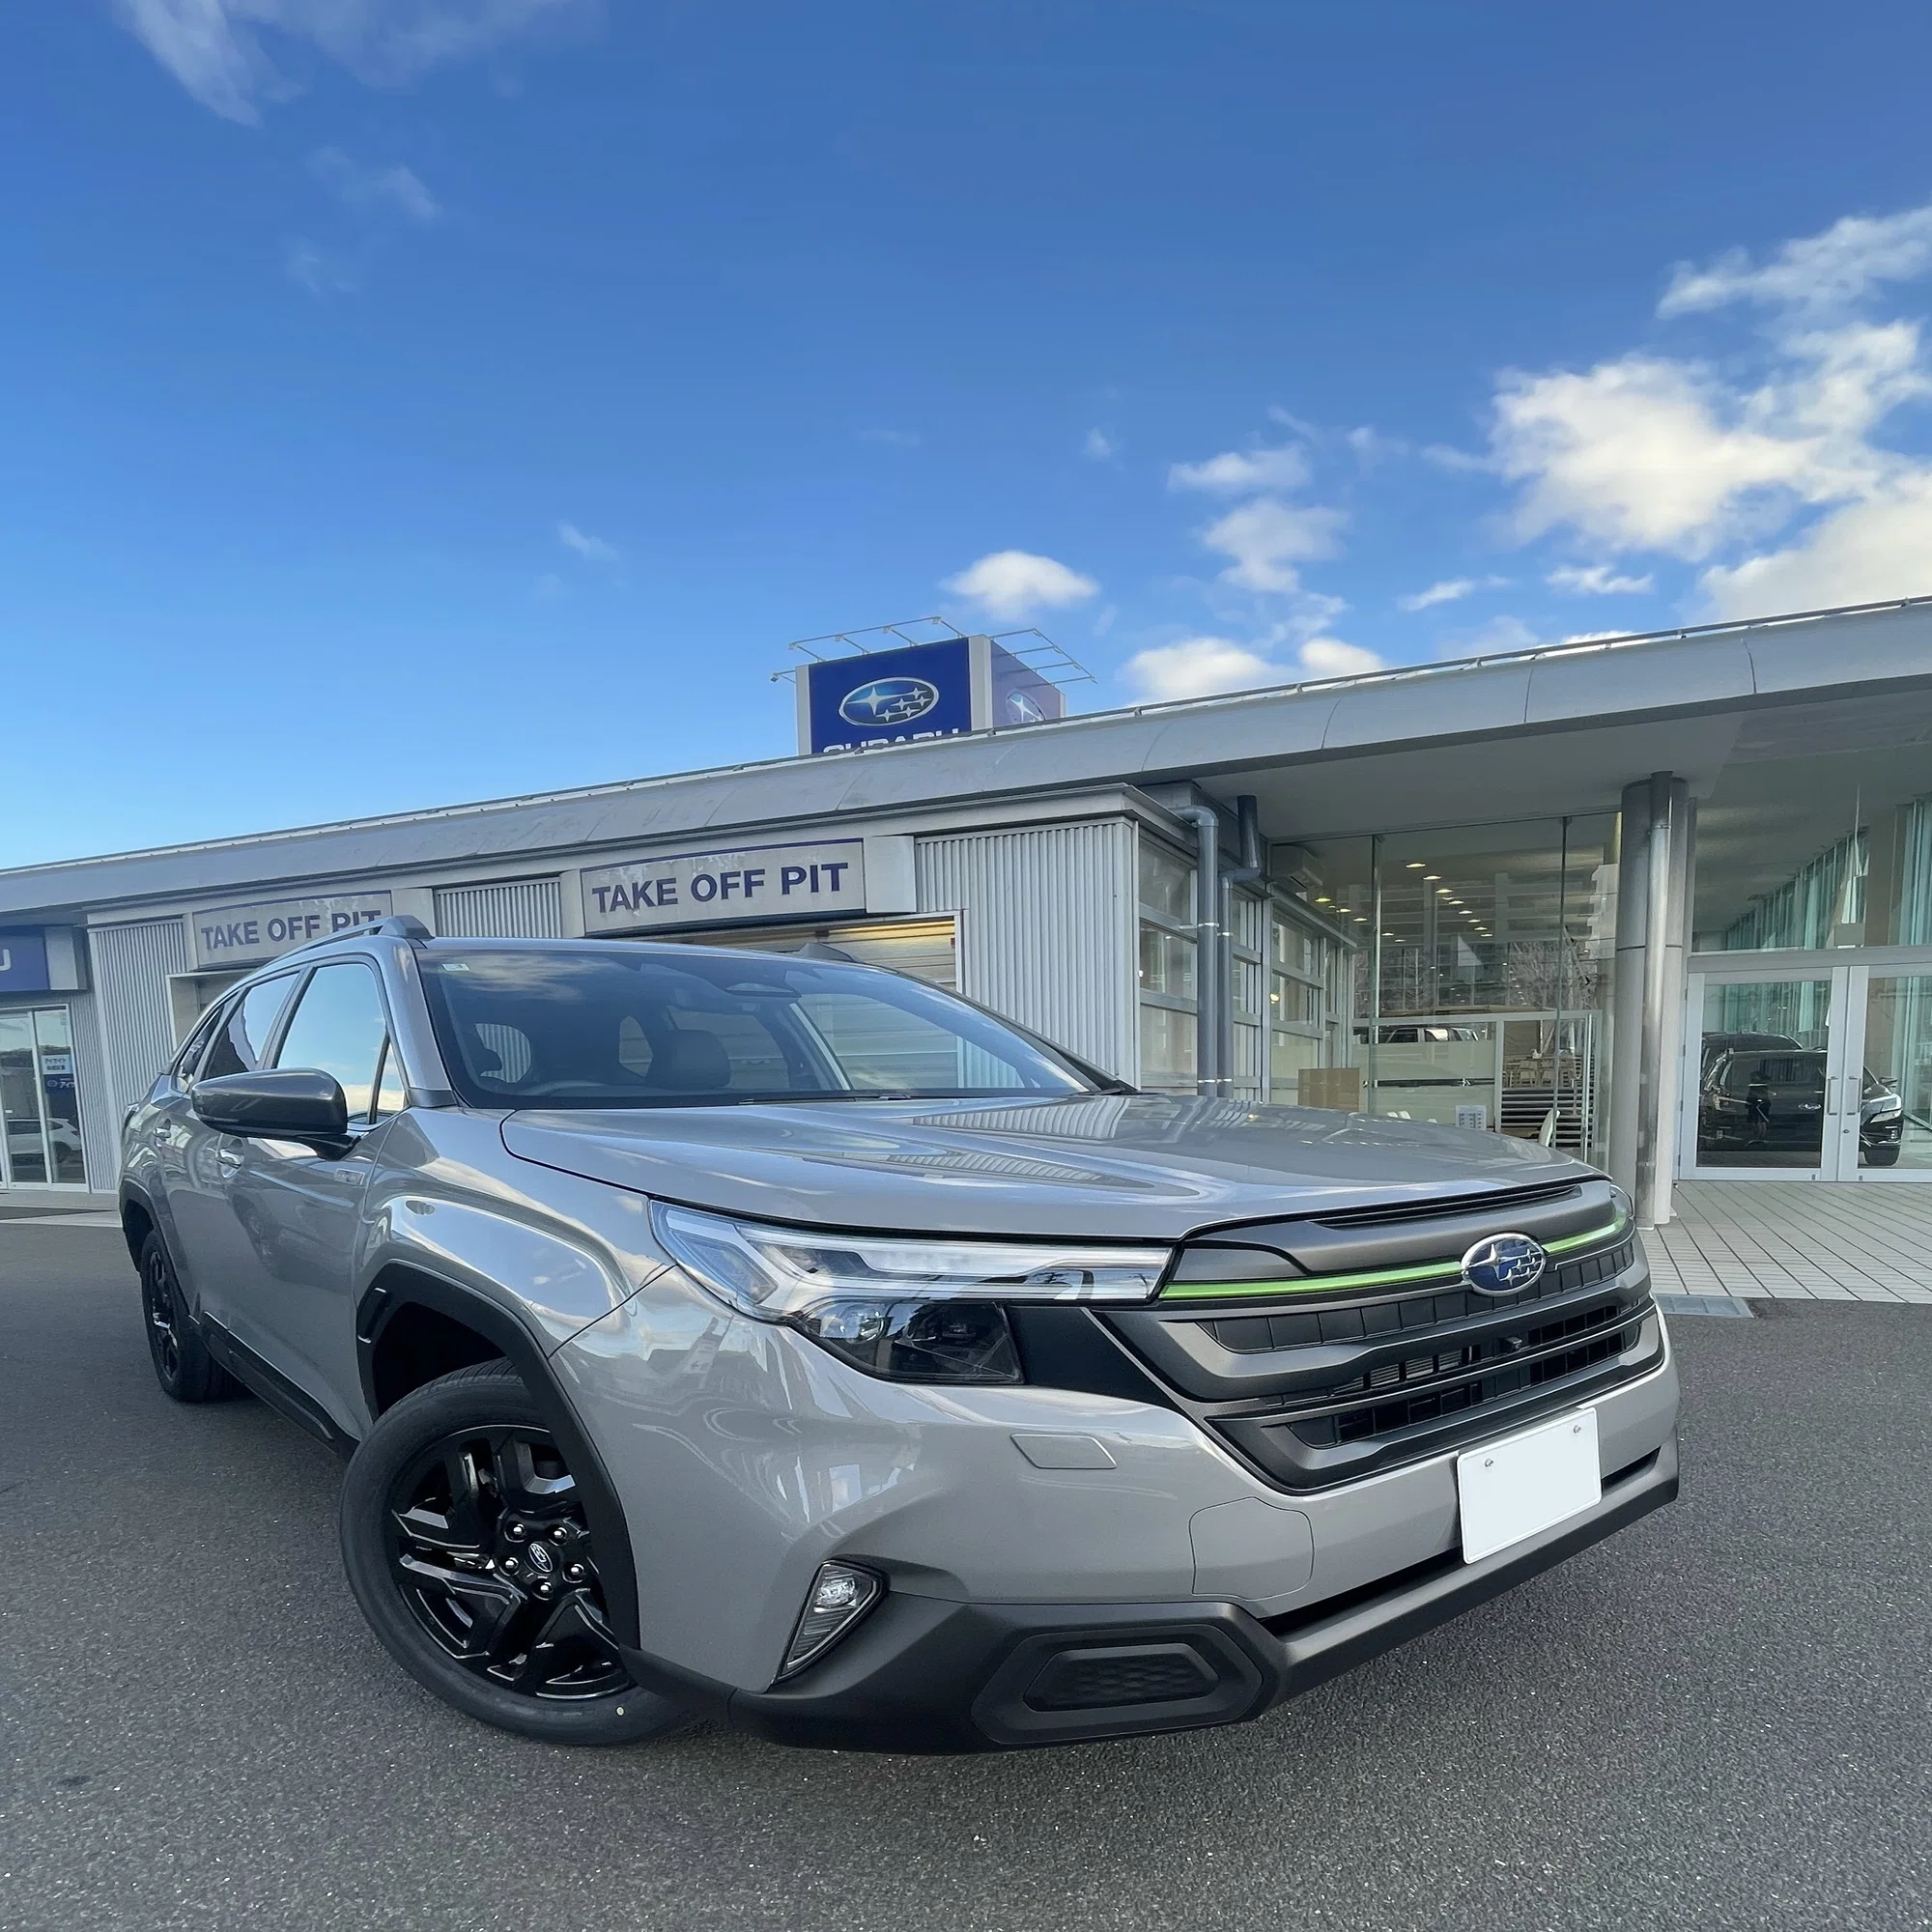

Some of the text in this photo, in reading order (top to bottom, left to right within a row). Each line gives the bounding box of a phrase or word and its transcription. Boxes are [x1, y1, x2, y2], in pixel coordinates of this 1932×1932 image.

[592, 863, 848, 913] TAKE OFF PIT
[201, 921, 260, 950] TAKE
[267, 915, 320, 942] OFF
